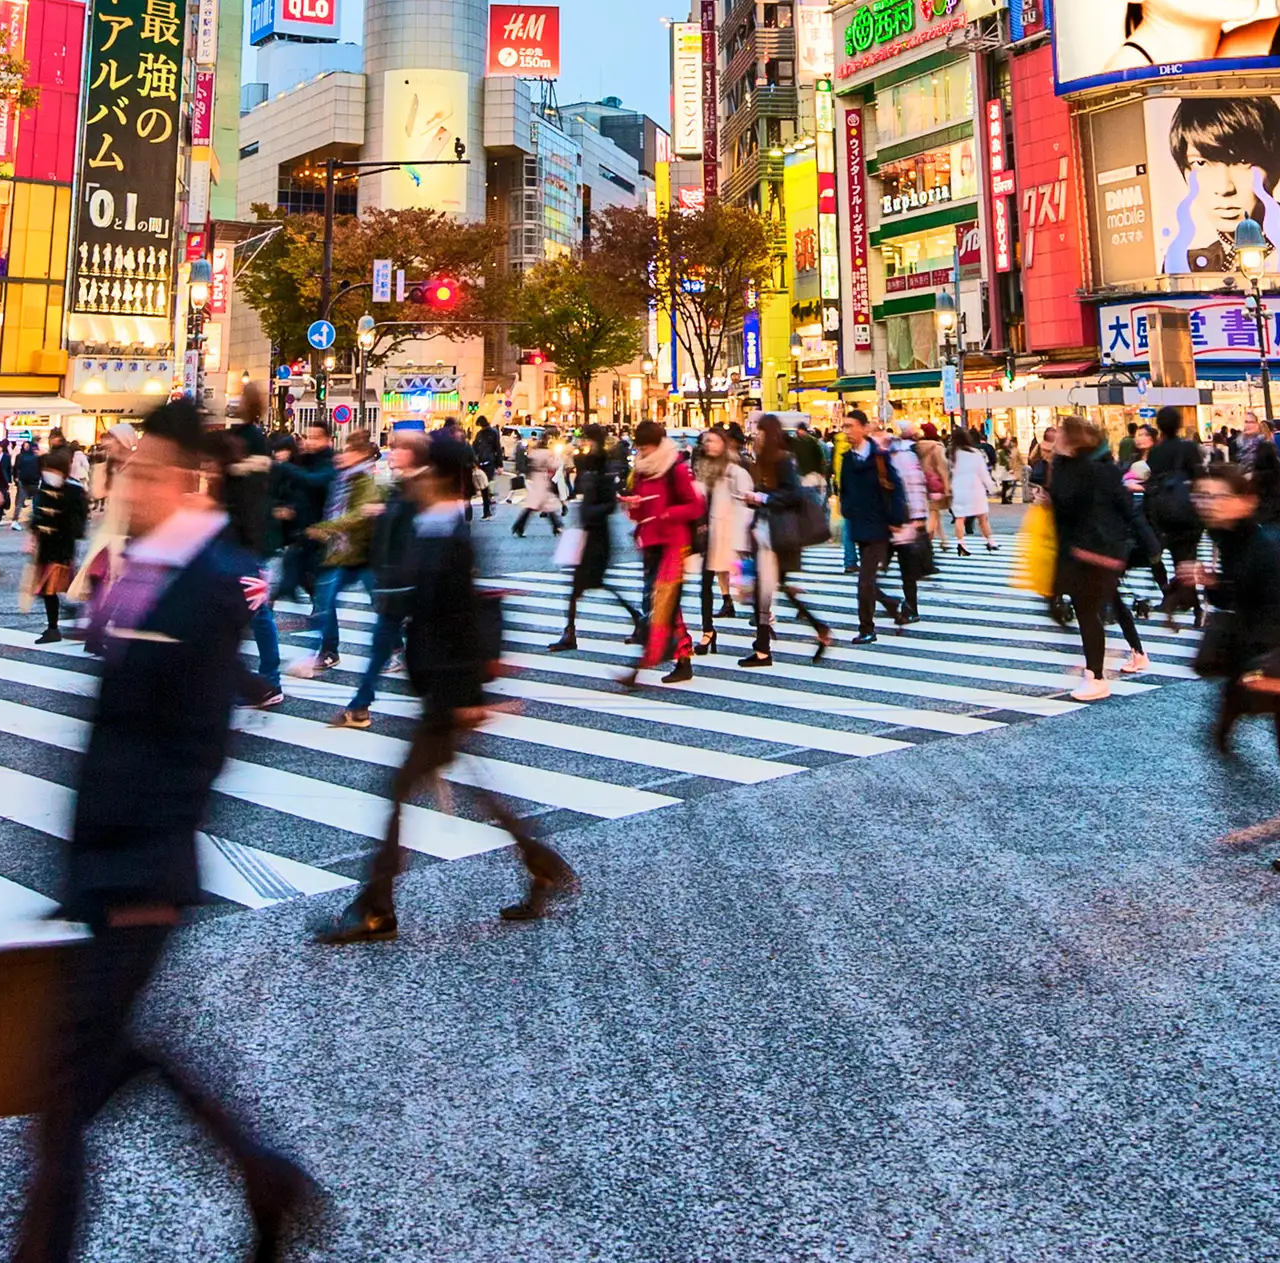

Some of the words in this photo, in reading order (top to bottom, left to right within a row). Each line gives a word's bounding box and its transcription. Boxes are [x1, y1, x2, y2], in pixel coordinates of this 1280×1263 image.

[503, 13, 546, 41] H&M
[519, 48, 543, 57] この先
[520, 57, 551, 68] 150m
[1159, 63, 1183, 75] DHC
[678, 56, 698, 150] Essential
[849, 138, 864, 257] ウィンターフルーツギフト
[882, 185, 950, 214] Euphoria
[1107, 206, 1145, 229] mobile
[1111, 230, 1144, 245] のスマホ
